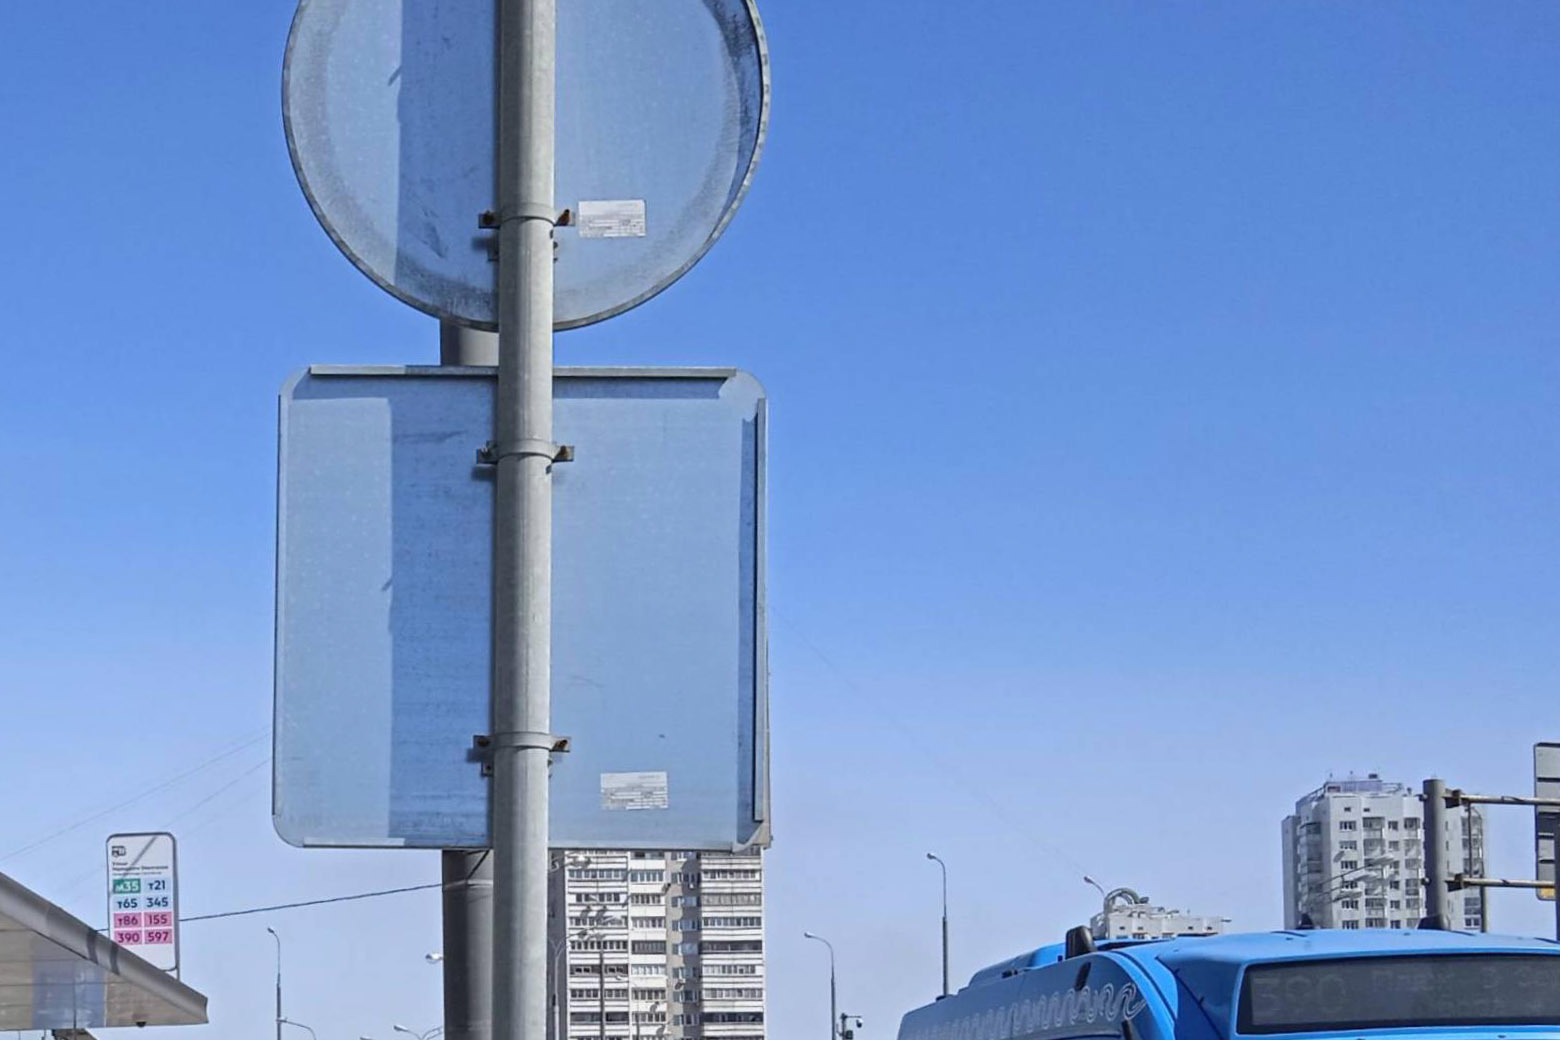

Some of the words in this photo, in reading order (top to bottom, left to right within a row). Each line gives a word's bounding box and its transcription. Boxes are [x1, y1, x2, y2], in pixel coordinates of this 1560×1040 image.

[146, 896, 169, 908] 345
[148, 914, 168, 925] 155
[118, 932, 140, 943] 390
[148, 931, 169, 942] 597
